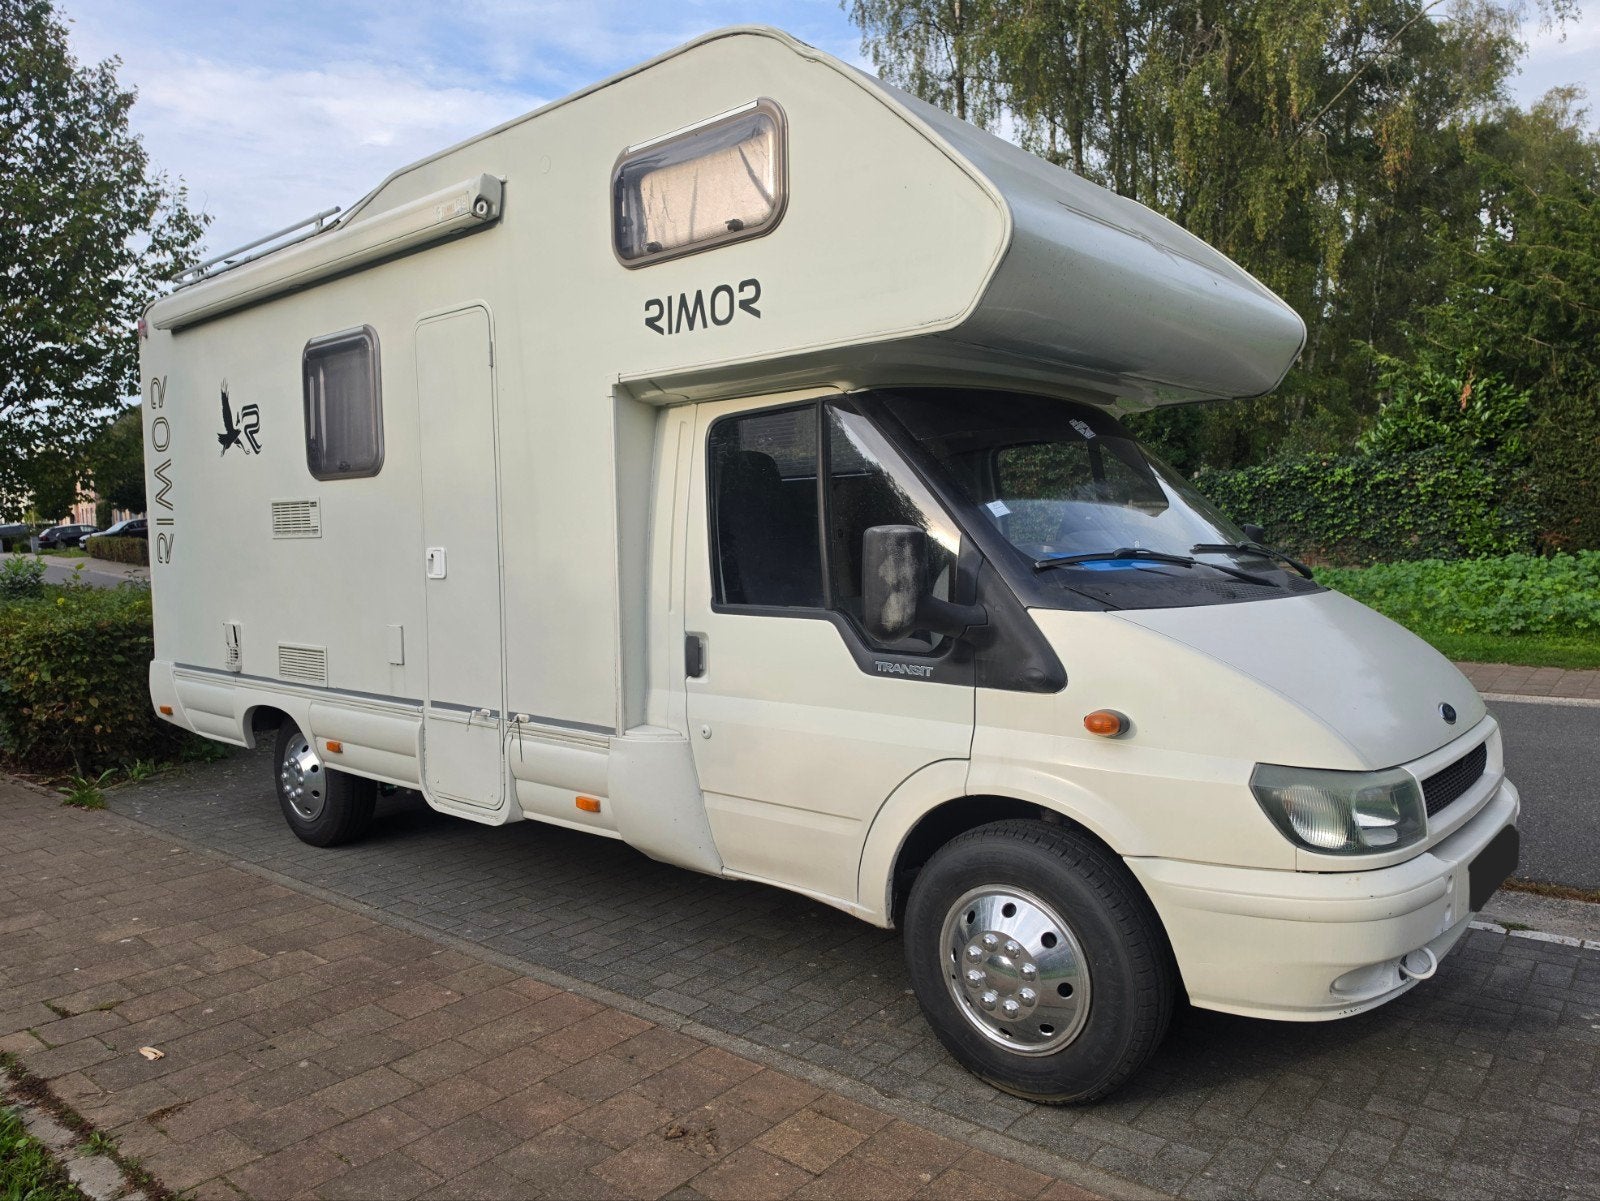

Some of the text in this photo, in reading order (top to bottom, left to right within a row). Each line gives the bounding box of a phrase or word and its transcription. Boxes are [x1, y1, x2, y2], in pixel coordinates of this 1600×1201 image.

[644, 277, 762, 336] RIMOR
[150, 374, 175, 565] RIMOR
[875, 661, 934, 678] TRANSIT
